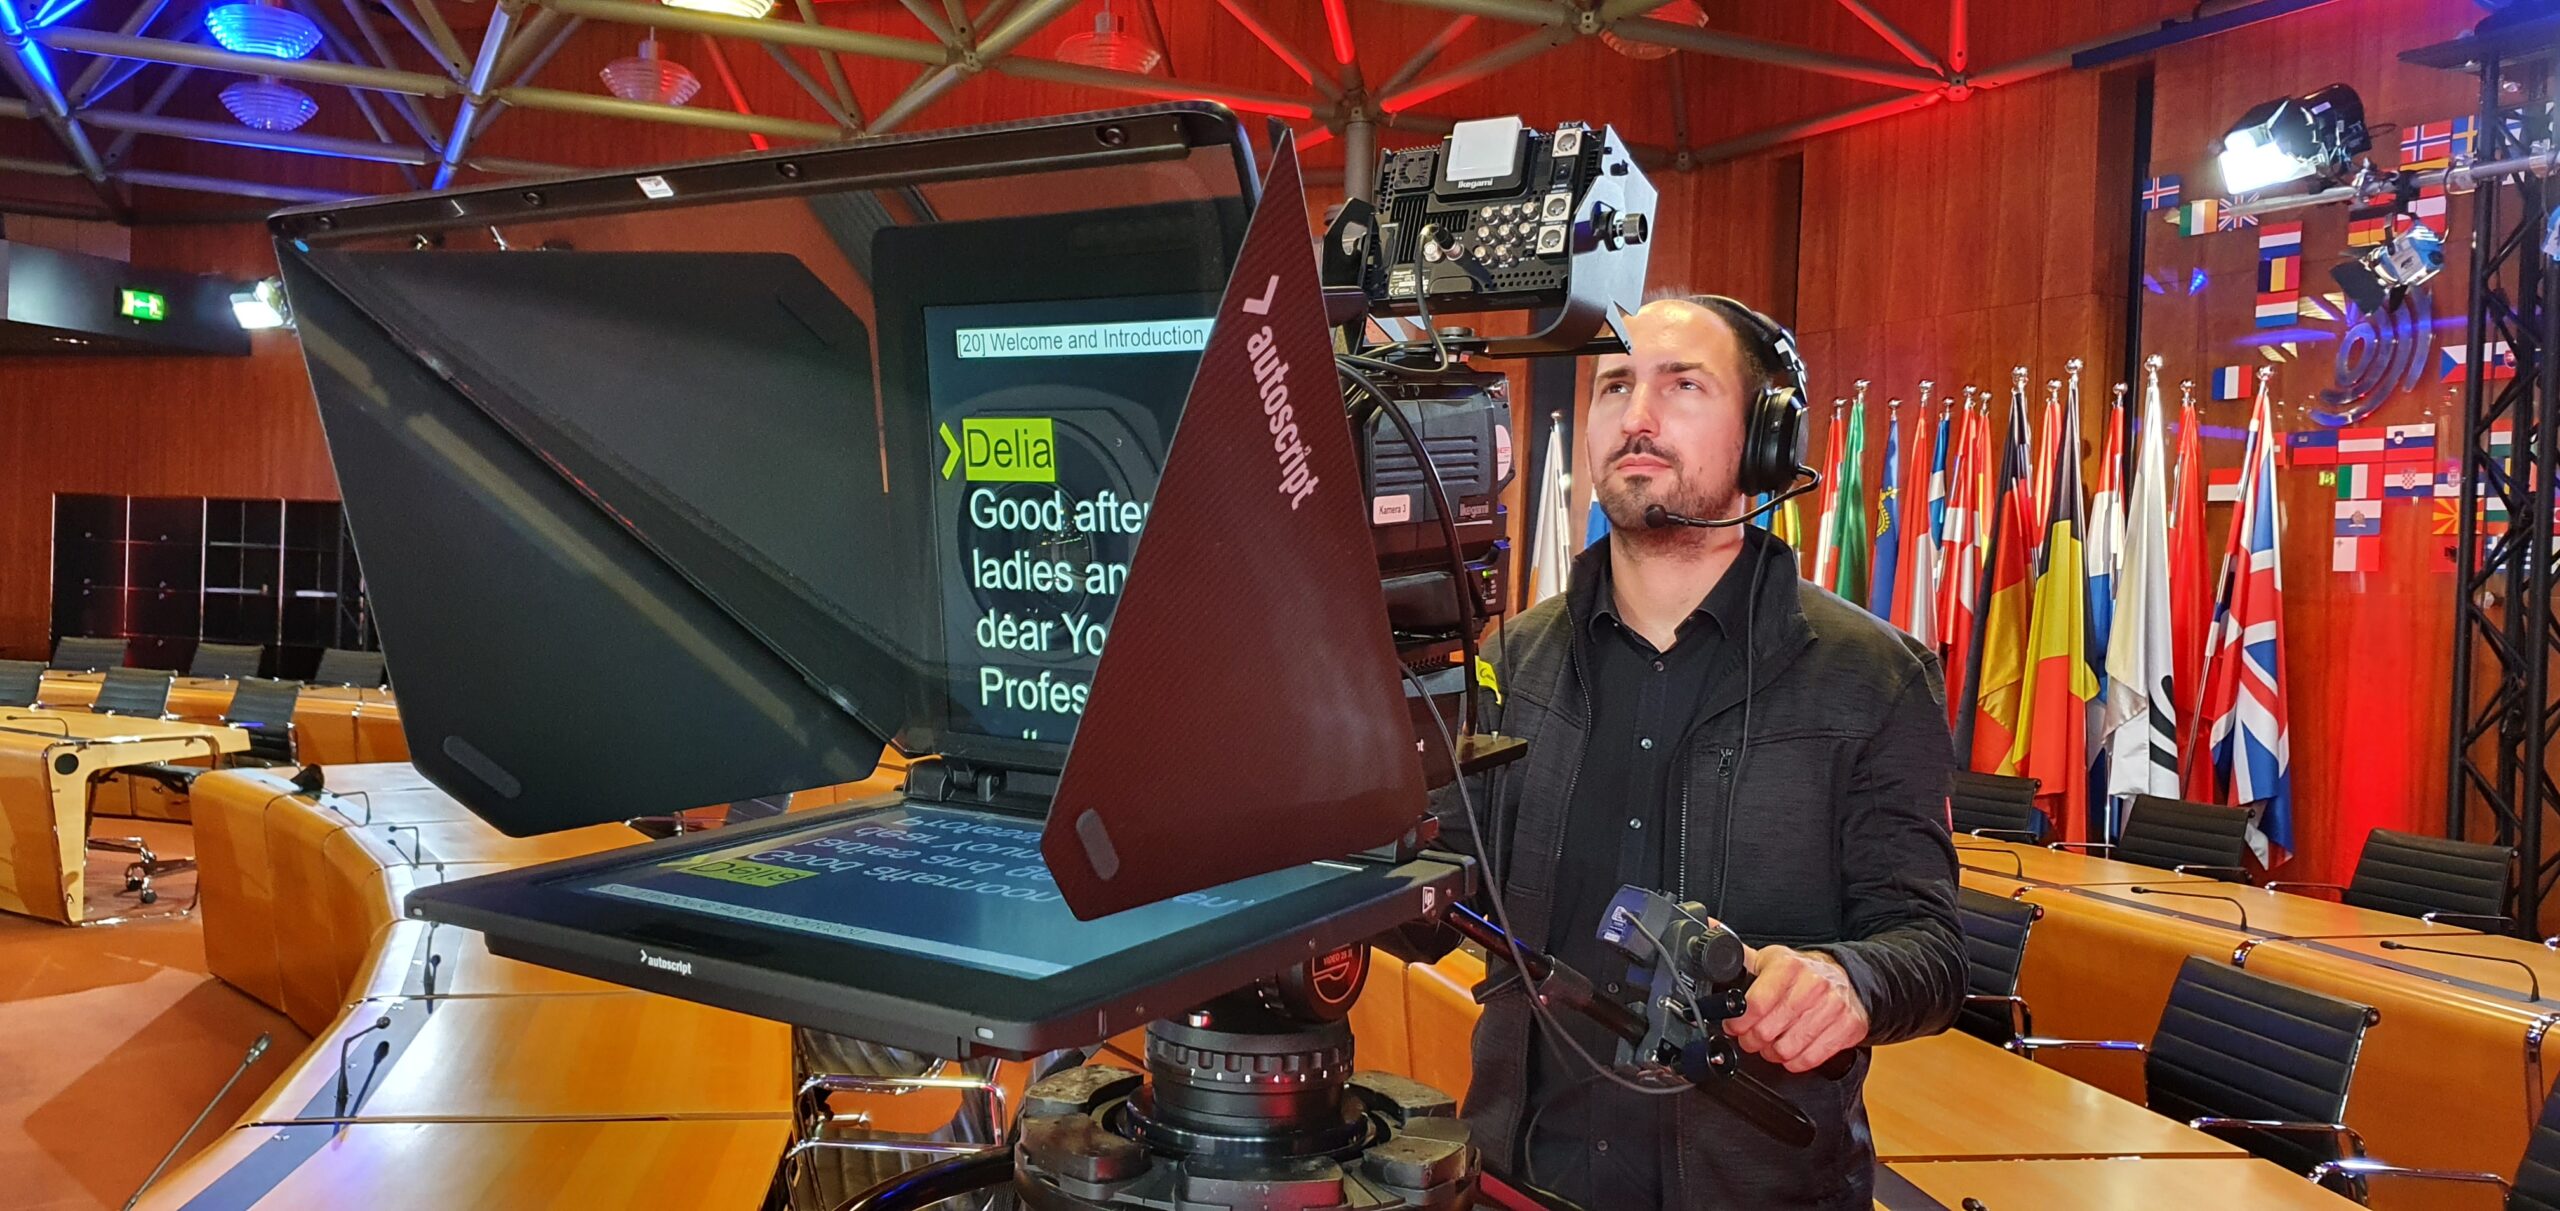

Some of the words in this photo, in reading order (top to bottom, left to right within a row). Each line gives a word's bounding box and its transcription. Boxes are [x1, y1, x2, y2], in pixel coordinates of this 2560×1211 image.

[958, 333, 986, 356] [20]
[990, 331, 1063, 351] Welcome
[1068, 329, 1098, 349] and
[1104, 325, 1203, 347] Introduction
[1246, 325, 1319, 511] autoscript
[966, 428, 1053, 469] Delia
[969, 488, 1062, 530] Good
[972, 548, 1073, 593] ladies
[976, 608, 1053, 651] dear
[980, 667, 1088, 714] Profes
[647, 956, 693, 976] autoscript
